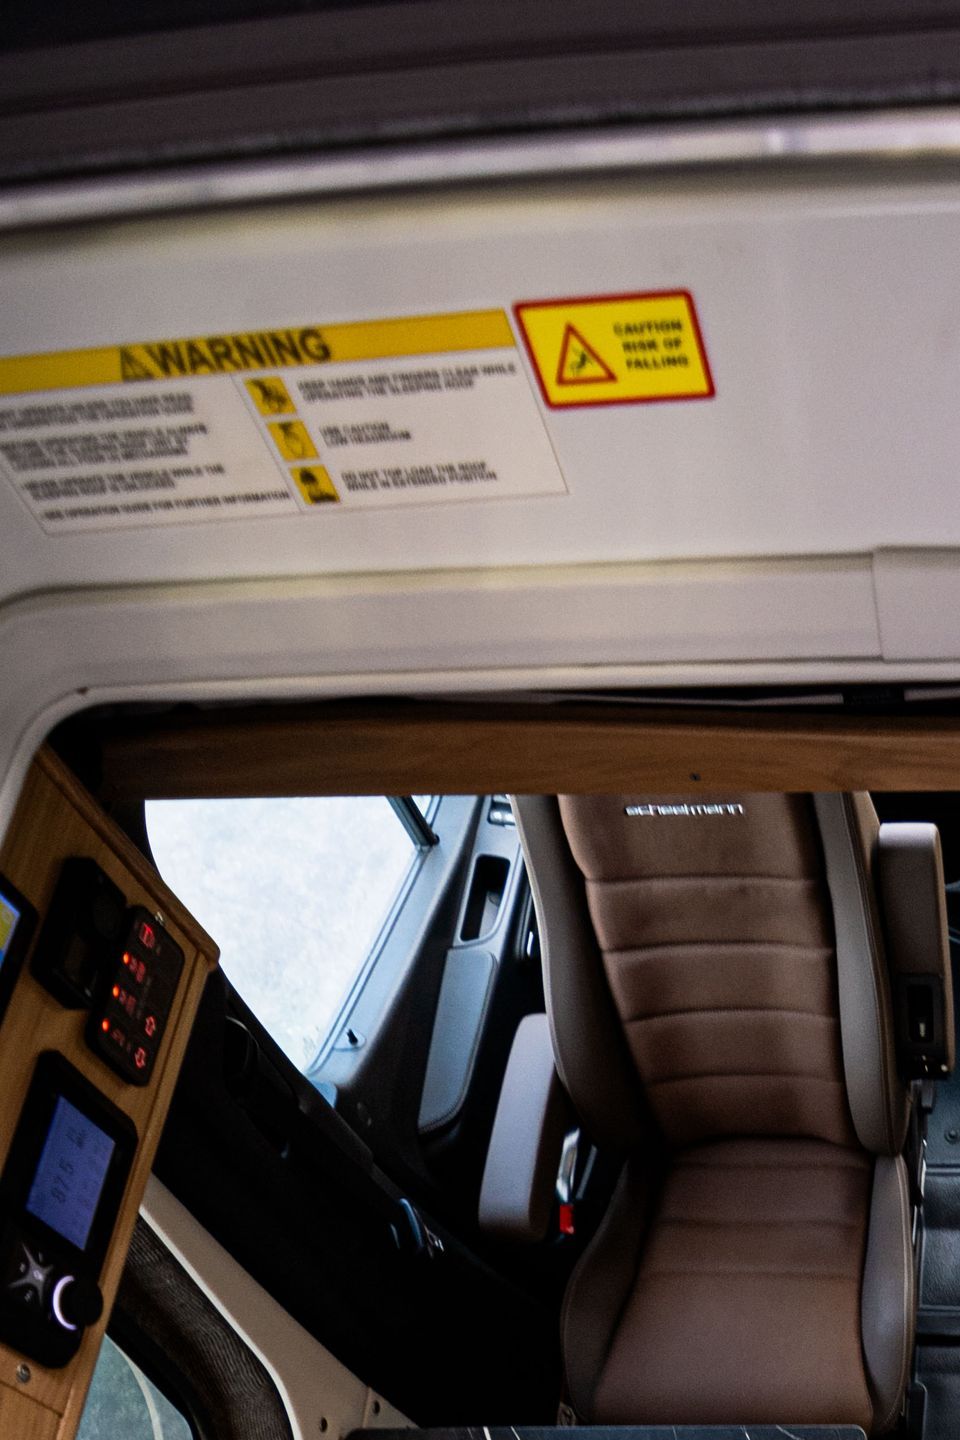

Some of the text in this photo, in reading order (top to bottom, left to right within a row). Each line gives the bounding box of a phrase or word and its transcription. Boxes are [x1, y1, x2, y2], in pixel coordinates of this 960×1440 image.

[613, 320, 683, 336] CAUTION
[663, 336, 682, 350] OF
[145, 327, 331, 376] WARNING
[626, 354, 689, 370] FALLING
